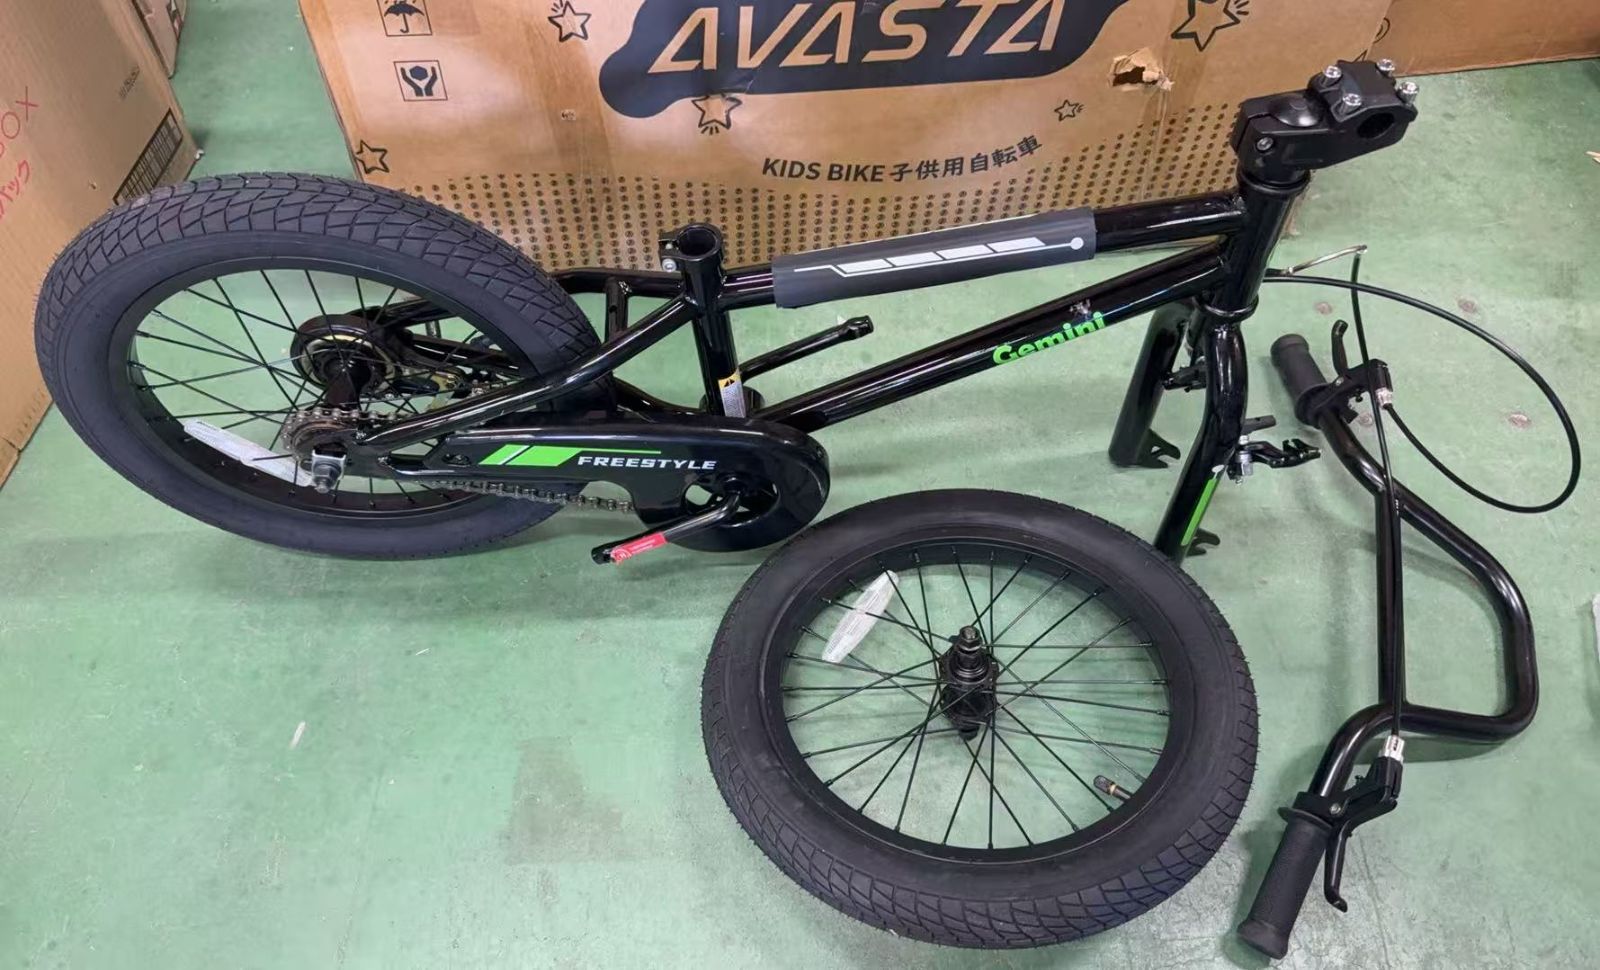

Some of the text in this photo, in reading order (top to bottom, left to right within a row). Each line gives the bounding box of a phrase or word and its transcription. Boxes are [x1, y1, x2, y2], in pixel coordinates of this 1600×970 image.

[648, 0, 1066, 74] AVASTA
[762, 135, 1043, 183] KIDS BIKE 子供用自転車
[992, 311, 1106, 365] Gemini
[577, 456, 718, 470] FREESTYLE
